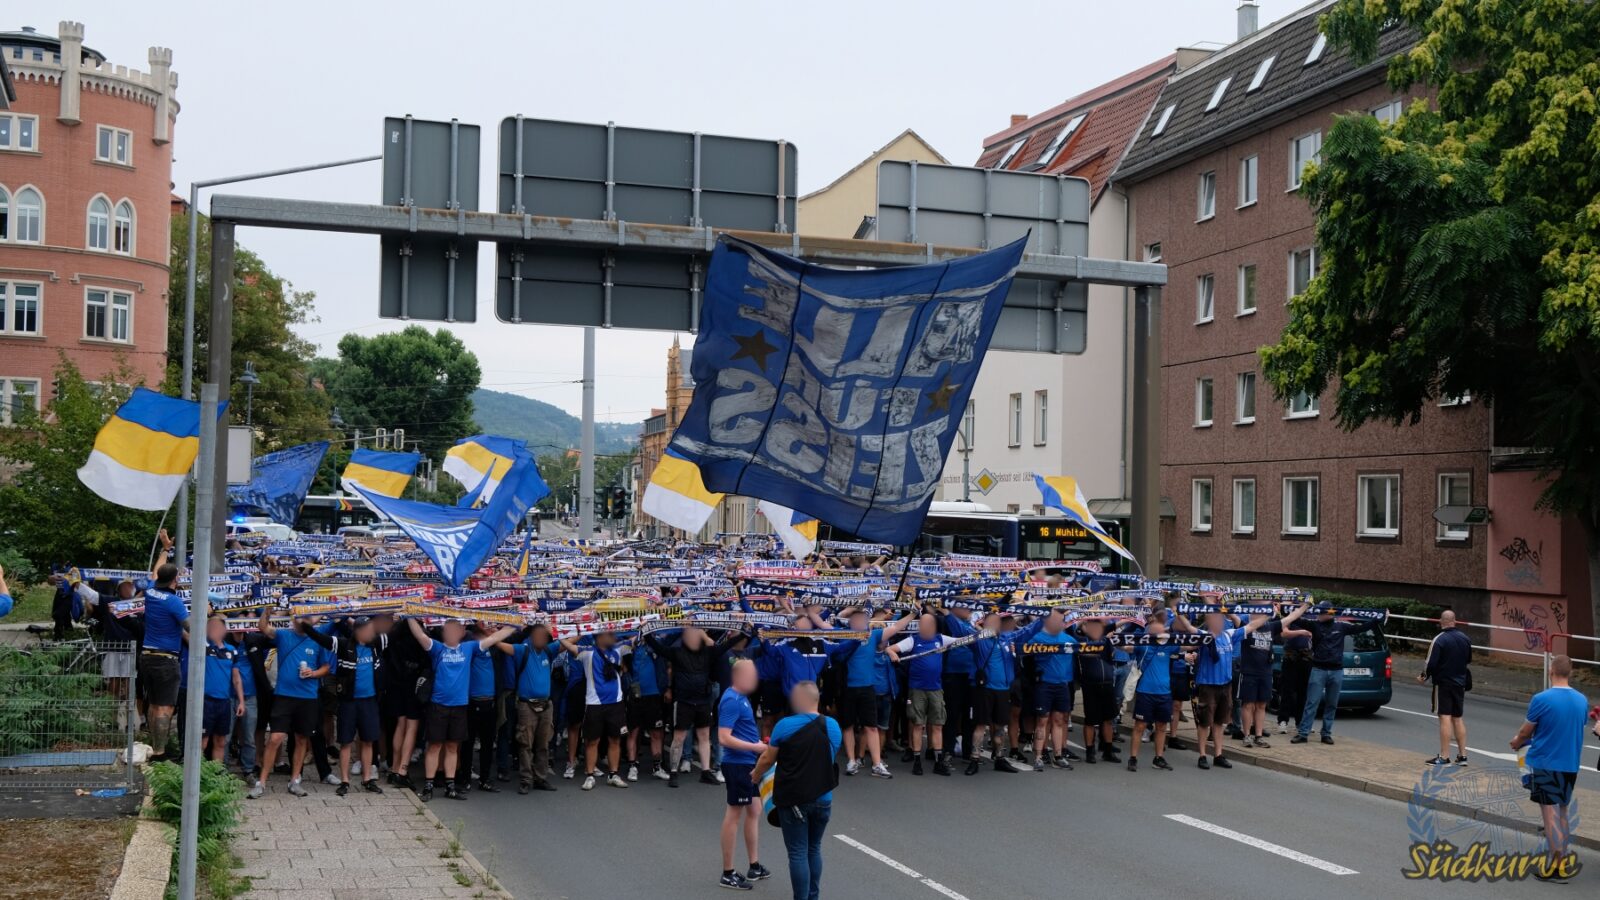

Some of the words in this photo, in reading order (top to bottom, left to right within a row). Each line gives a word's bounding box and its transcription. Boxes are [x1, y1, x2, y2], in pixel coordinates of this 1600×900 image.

[1040, 527, 1050, 537] 16
[224, 566, 261, 574] ARTMANN
[919, 589, 956, 598] Horda
[944, 600, 984, 611] Horda
[1179, 604, 1214, 613] Horda
[244, 621, 290, 629] LAUNNE
